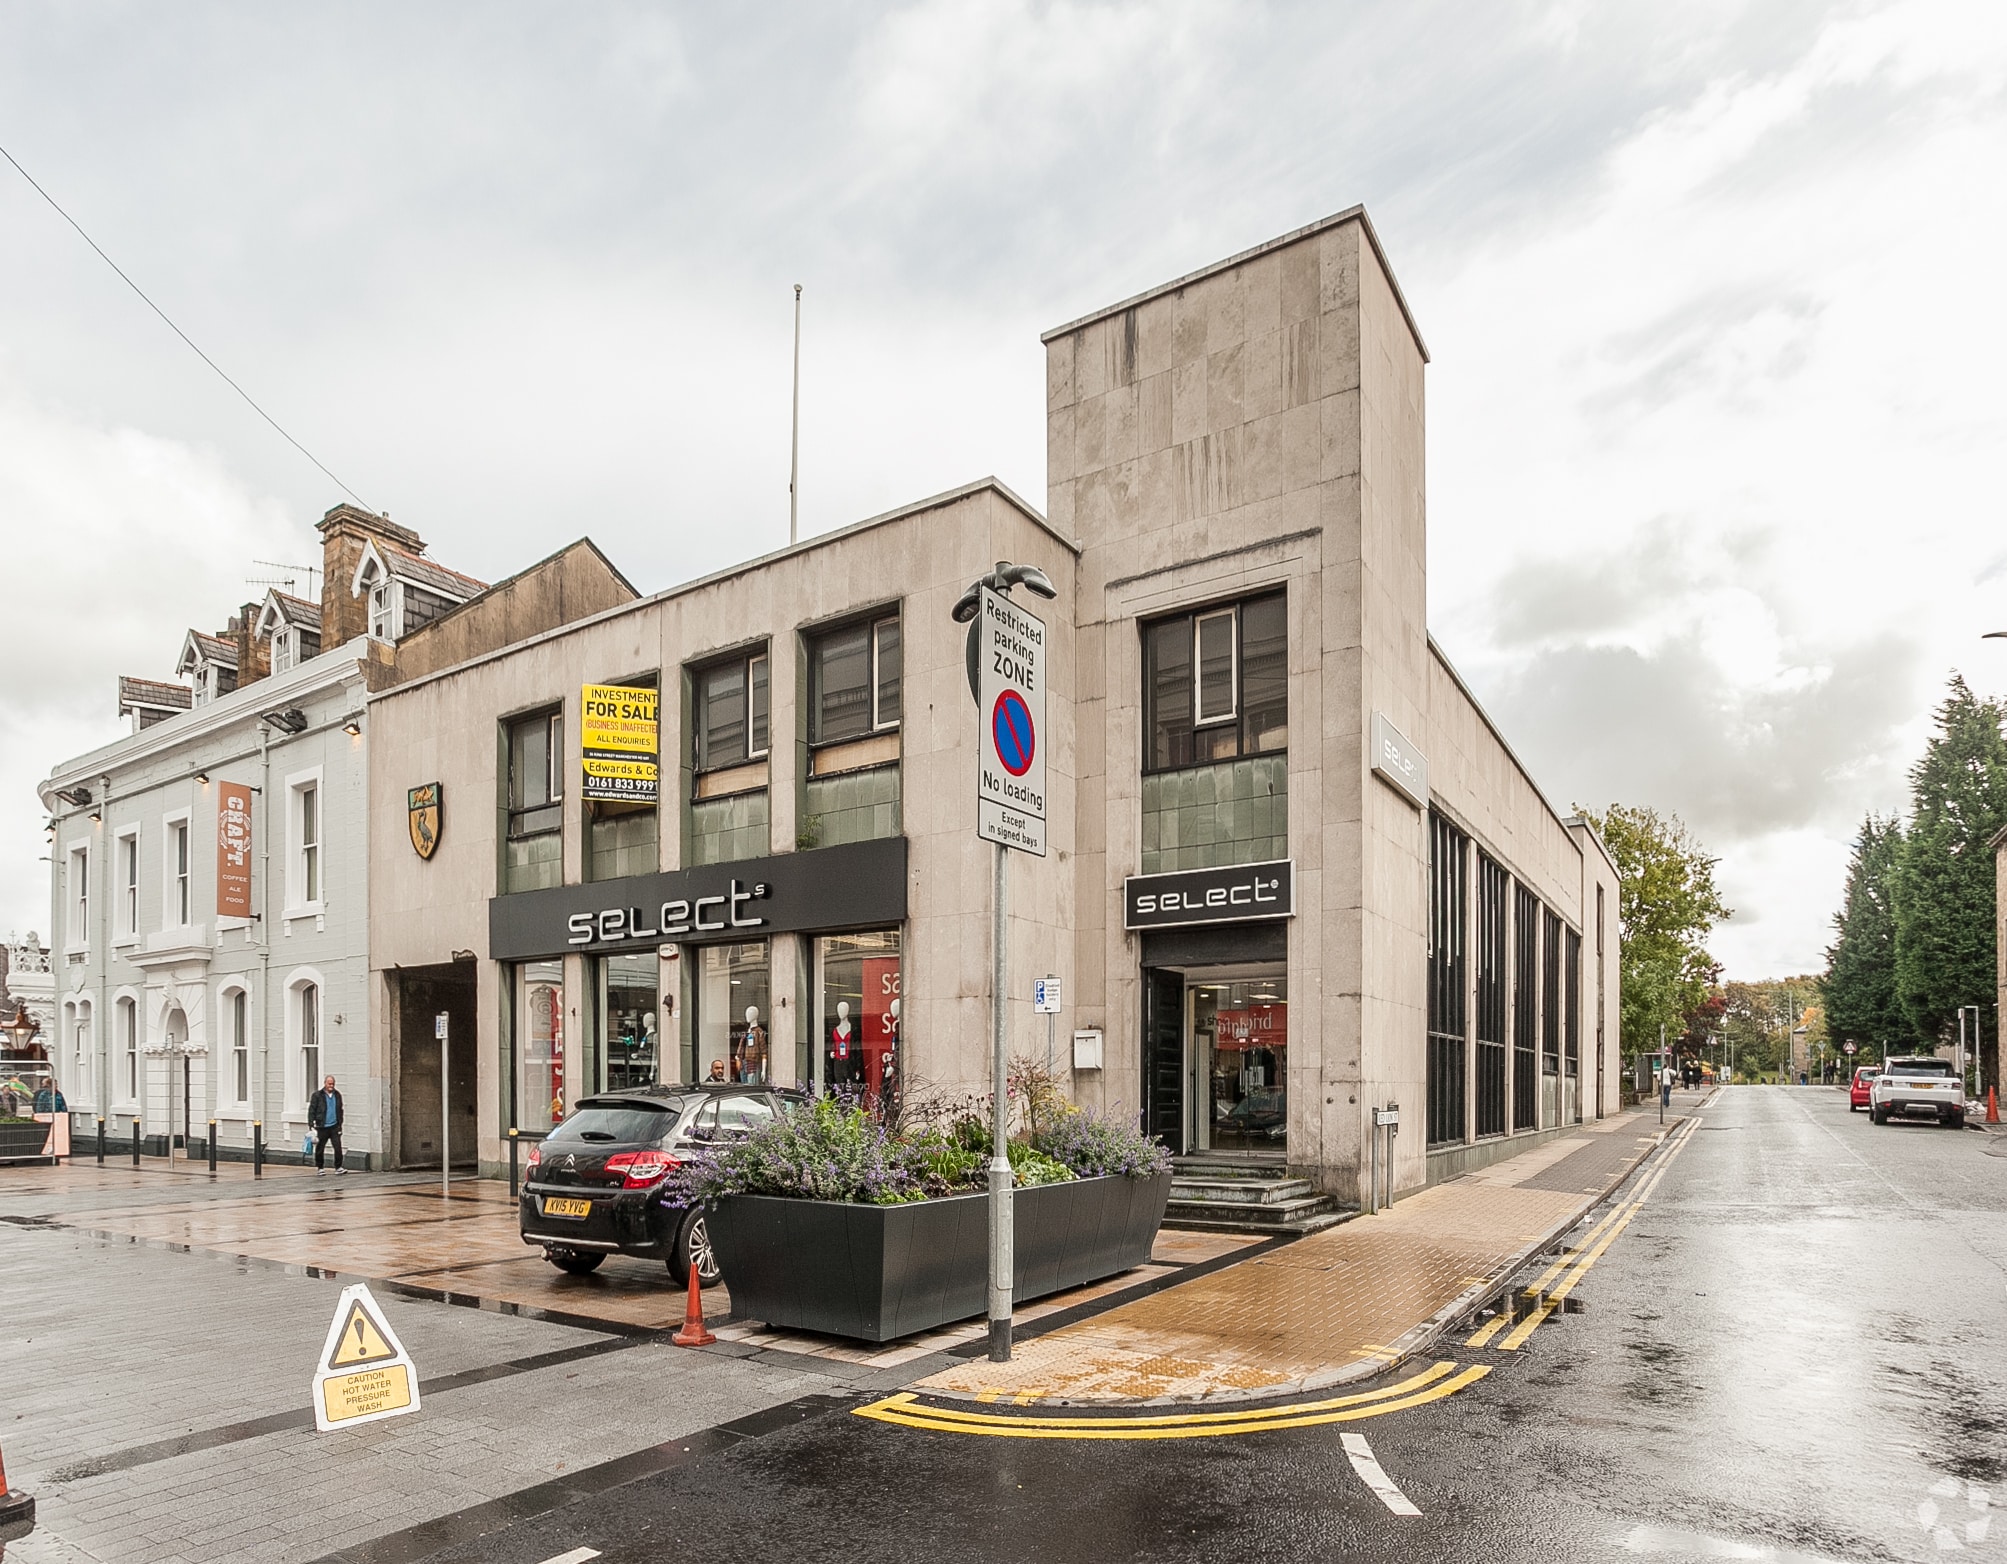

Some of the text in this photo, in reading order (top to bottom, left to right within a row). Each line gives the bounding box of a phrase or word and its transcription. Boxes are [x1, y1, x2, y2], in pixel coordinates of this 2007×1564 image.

[987, 598, 1041, 645] Restricted
[994, 630, 1034, 666] parking
[994, 650, 1034, 691] ZONE
[592, 688, 657, 703] INVESTMENT
[586, 701, 658, 721] FOR SALE
[597, 734, 650, 746] ALL ENQUIRIES
[589, 762, 632, 774] Edwards
[635, 765, 643, 776] &
[588, 776, 612, 788] 0161
[615, 778, 634, 789] 833
[983, 769, 1042, 811] No loading
[1002, 811, 1026, 830] Except
[988, 821, 1038, 848] in signed bays
[222, 874, 248, 883] COFFEE
[225, 896, 245, 904] FOOD
[568, 1201, 585, 1214] YVG
[347, 1371, 385, 1385] CAUTION
[342, 1380, 391, 1395] HOT WATER
[346, 1390, 390, 1405] PRESSURE
[357, 1401, 382, 1413] WASH
